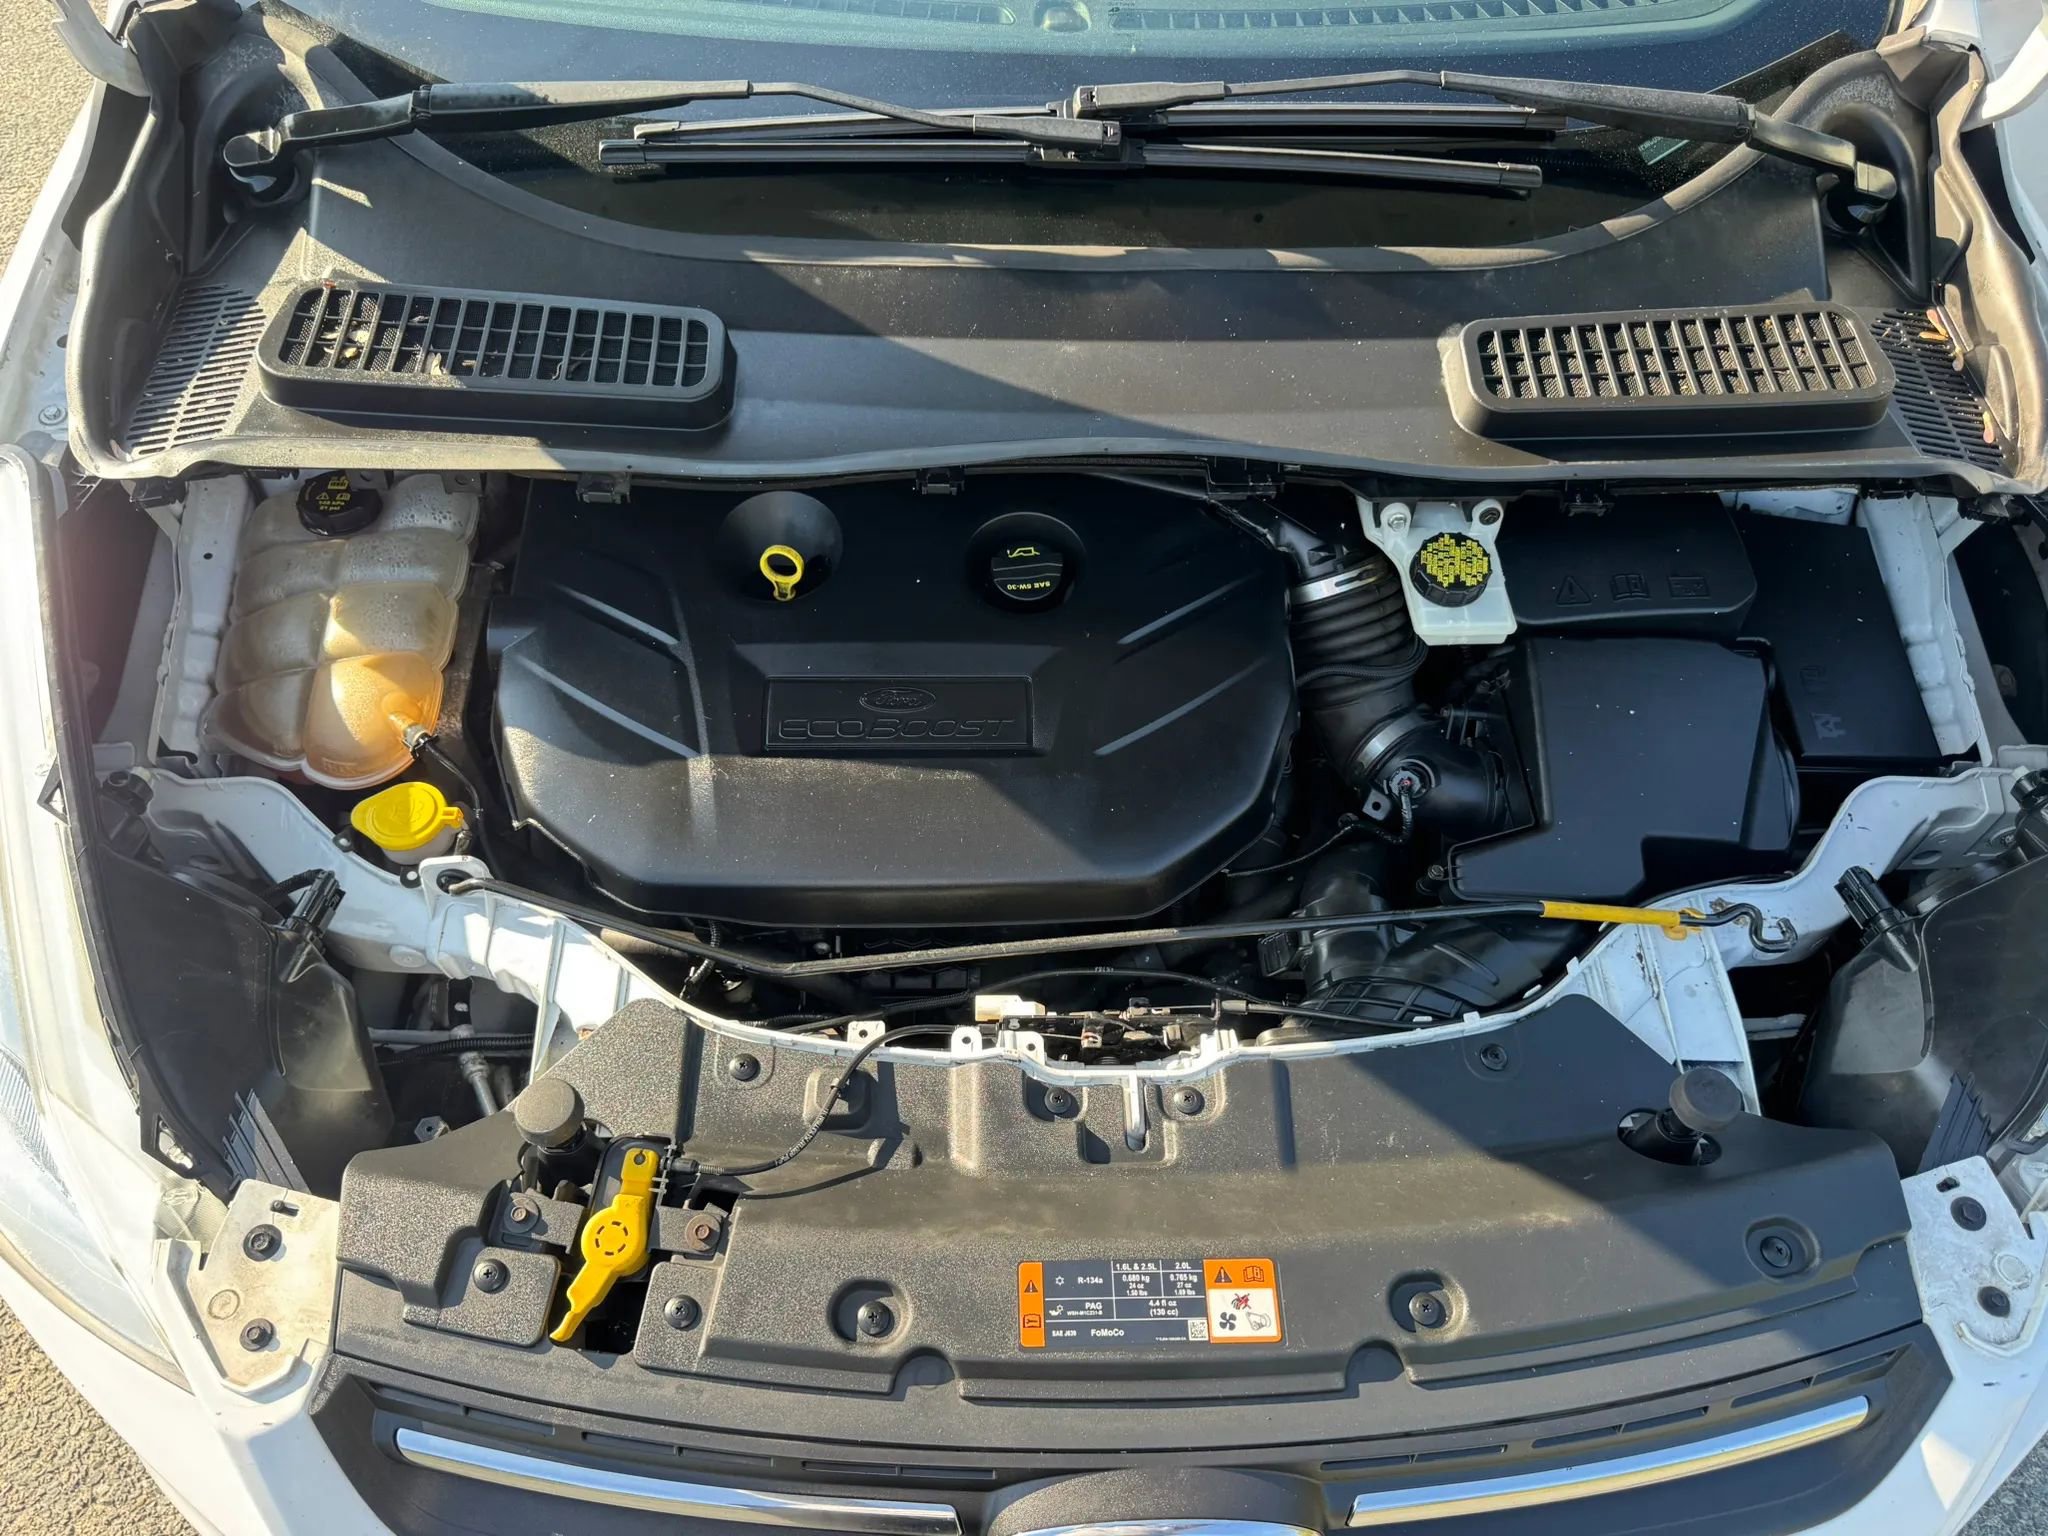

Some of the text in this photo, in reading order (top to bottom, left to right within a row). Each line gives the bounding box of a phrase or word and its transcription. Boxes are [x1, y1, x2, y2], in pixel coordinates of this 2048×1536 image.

[1116, 1263, 1132, 1271] 1.6L
[1175, 1262, 1191, 1270] 2.0L
[1077, 1276, 1103, 1284] R-134a
[1141, 1274, 1150, 1283] kg
[1189, 1273, 1198, 1283] kg
[1085, 1301, 1103, 1310] PAG
[1167, 1308, 1179, 1316] cc)
[1090, 1328, 1125, 1337] FoMoCo
